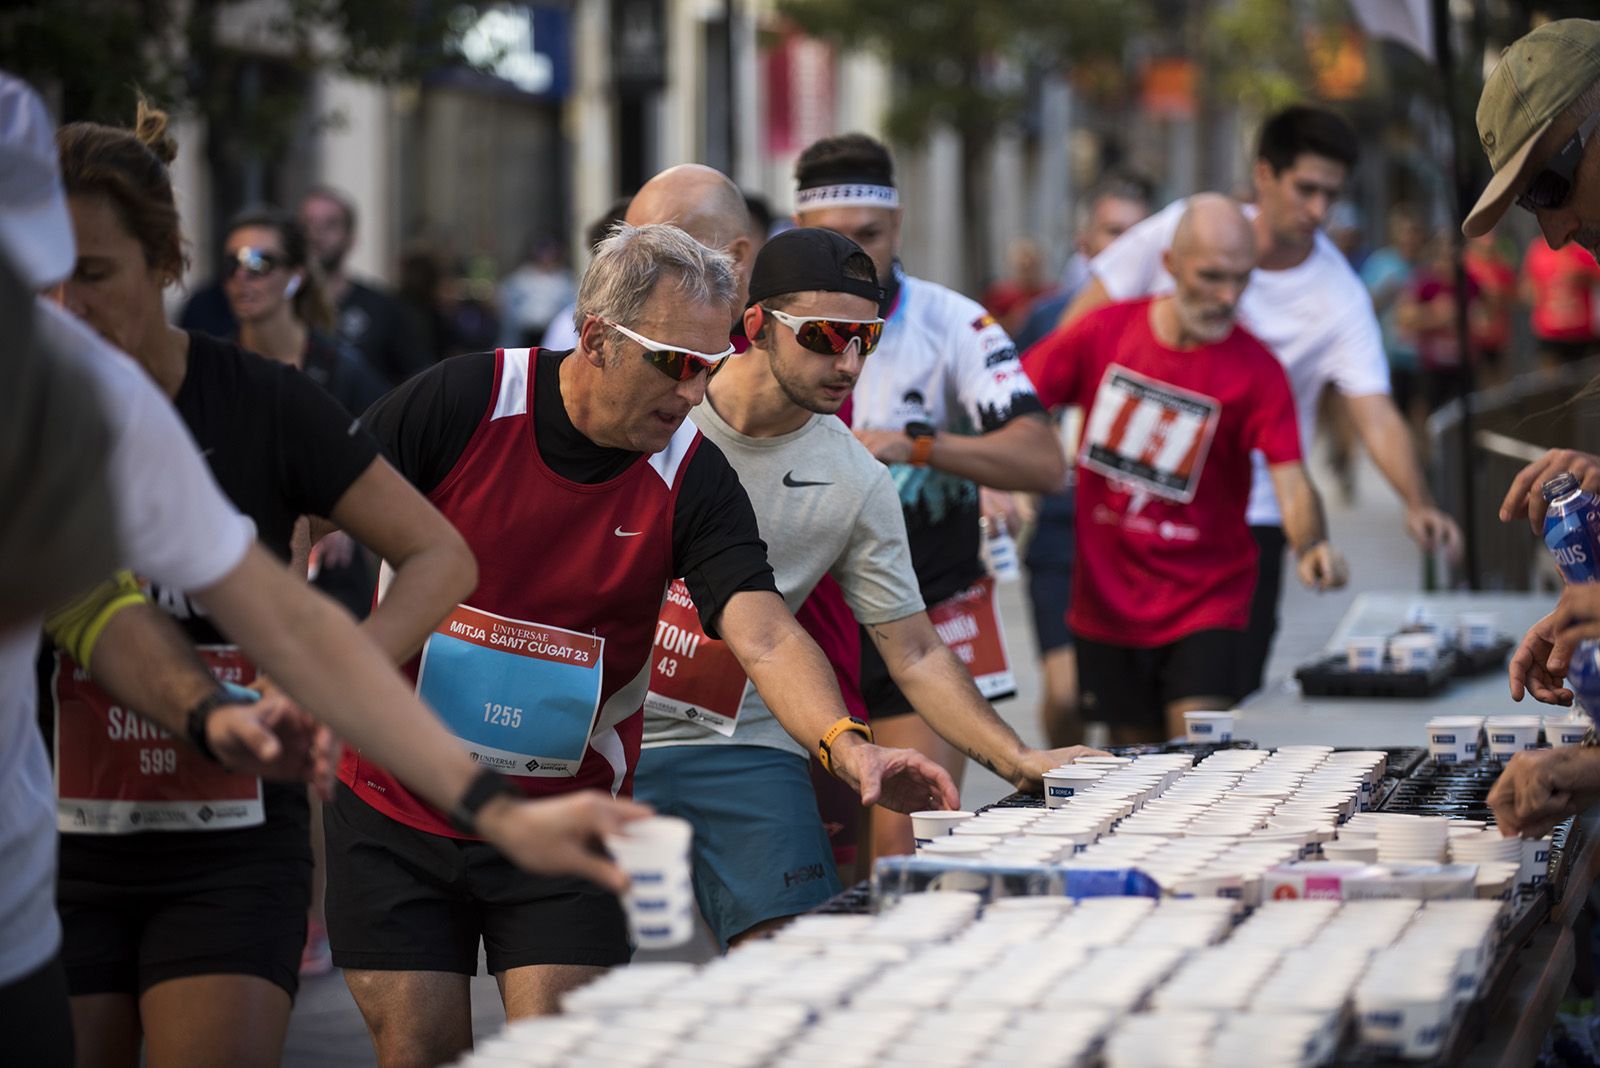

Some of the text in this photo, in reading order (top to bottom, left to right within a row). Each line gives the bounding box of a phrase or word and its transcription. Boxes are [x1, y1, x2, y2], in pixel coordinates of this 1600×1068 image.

[450, 620, 590, 662] MITJA SANT CUGAT 23
[492, 623, 550, 643] UNIVERSAE
[657, 656, 678, 678] 43
[483, 702, 523, 729] 1255
[140, 748, 176, 775] 599
[480, 754, 517, 767] UNIVERSAE
